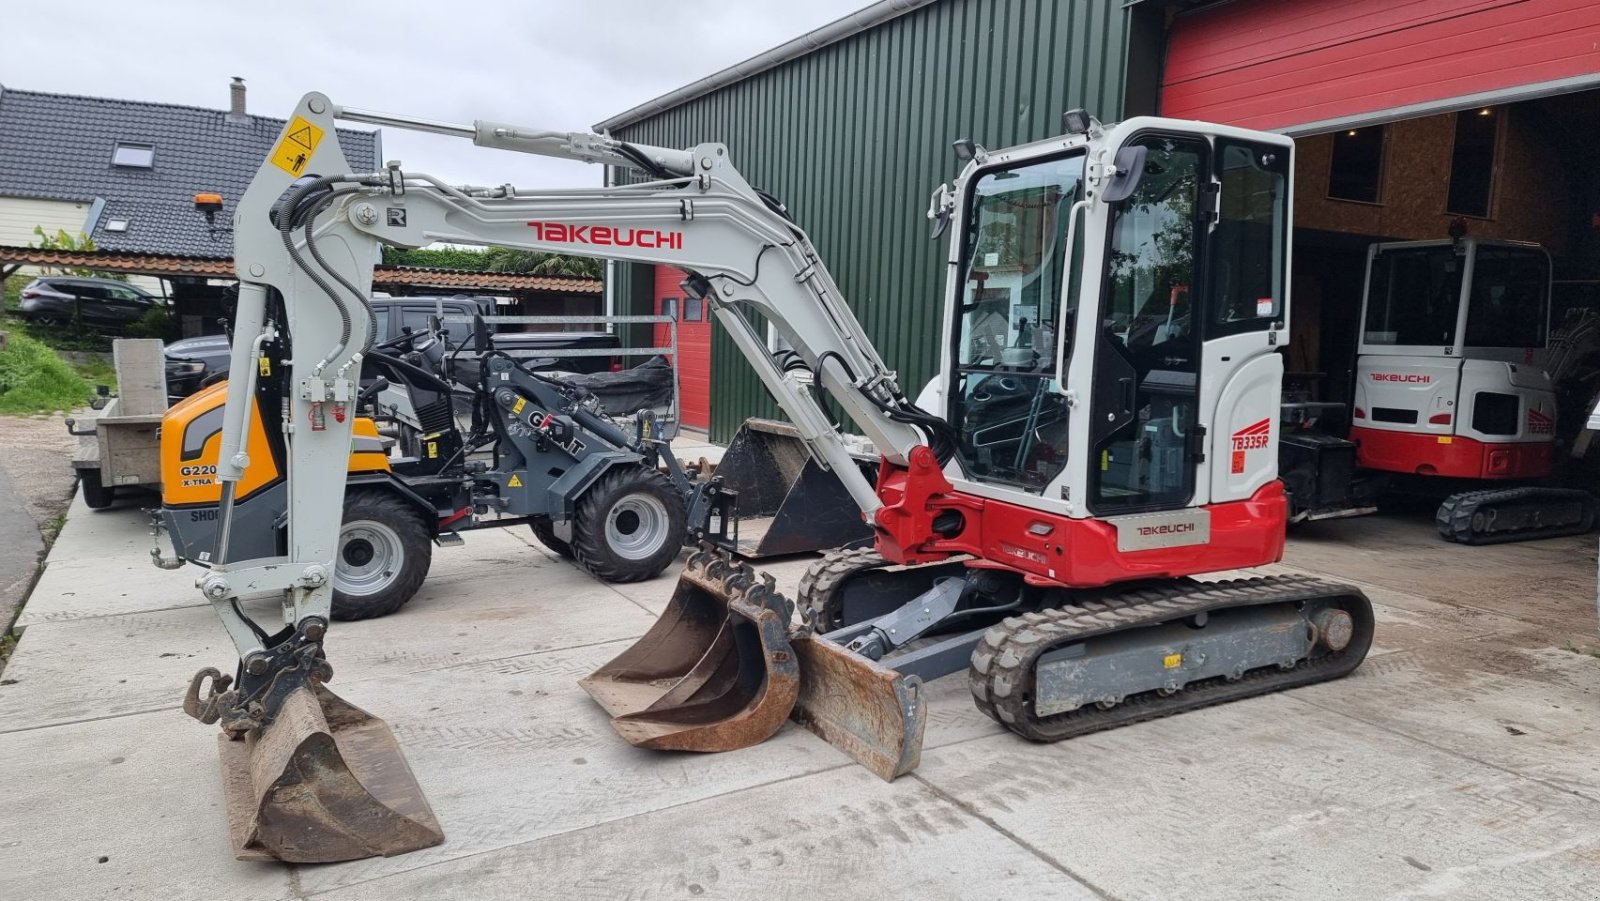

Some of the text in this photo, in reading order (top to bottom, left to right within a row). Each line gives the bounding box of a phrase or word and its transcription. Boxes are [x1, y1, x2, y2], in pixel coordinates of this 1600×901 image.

[527, 222, 682, 249] TAKEUCHI
[1370, 373, 1430, 383] TAKEUCHI
[1231, 435, 1269, 450] TB335R
[183, 478, 212, 488] X-TRA
[1136, 523, 1195, 536] TAKEUCHI
